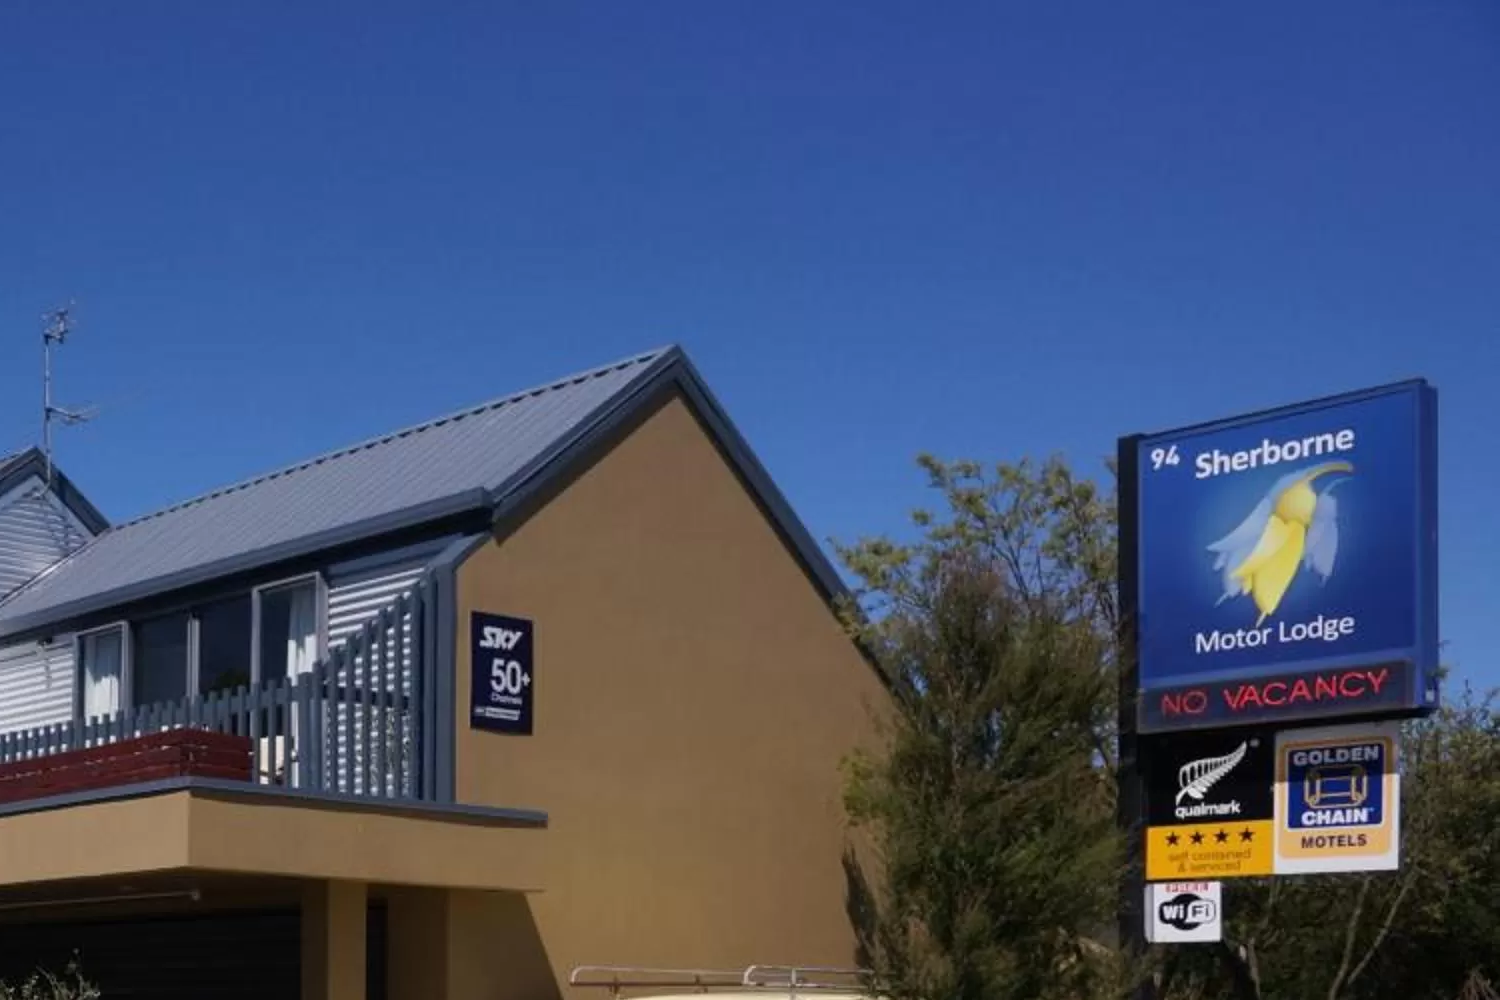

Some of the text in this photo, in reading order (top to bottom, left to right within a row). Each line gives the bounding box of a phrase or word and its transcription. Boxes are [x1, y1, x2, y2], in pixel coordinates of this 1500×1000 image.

[1150, 444, 1180, 470] 94
[1195, 429, 1355, 479] Sherborne
[479, 625, 523, 650] SKY
[1195, 615, 1355, 654] Motor Lodge
[490, 657, 531, 695] 50+
[1161, 668, 1389, 716] NO VACANCY
[1293, 745, 1379, 766] GOLDEN
[1175, 800, 1241, 819] qualmark
[1301, 808, 1368, 826] CHAIN
[1301, 833, 1367, 849] MOTELS
